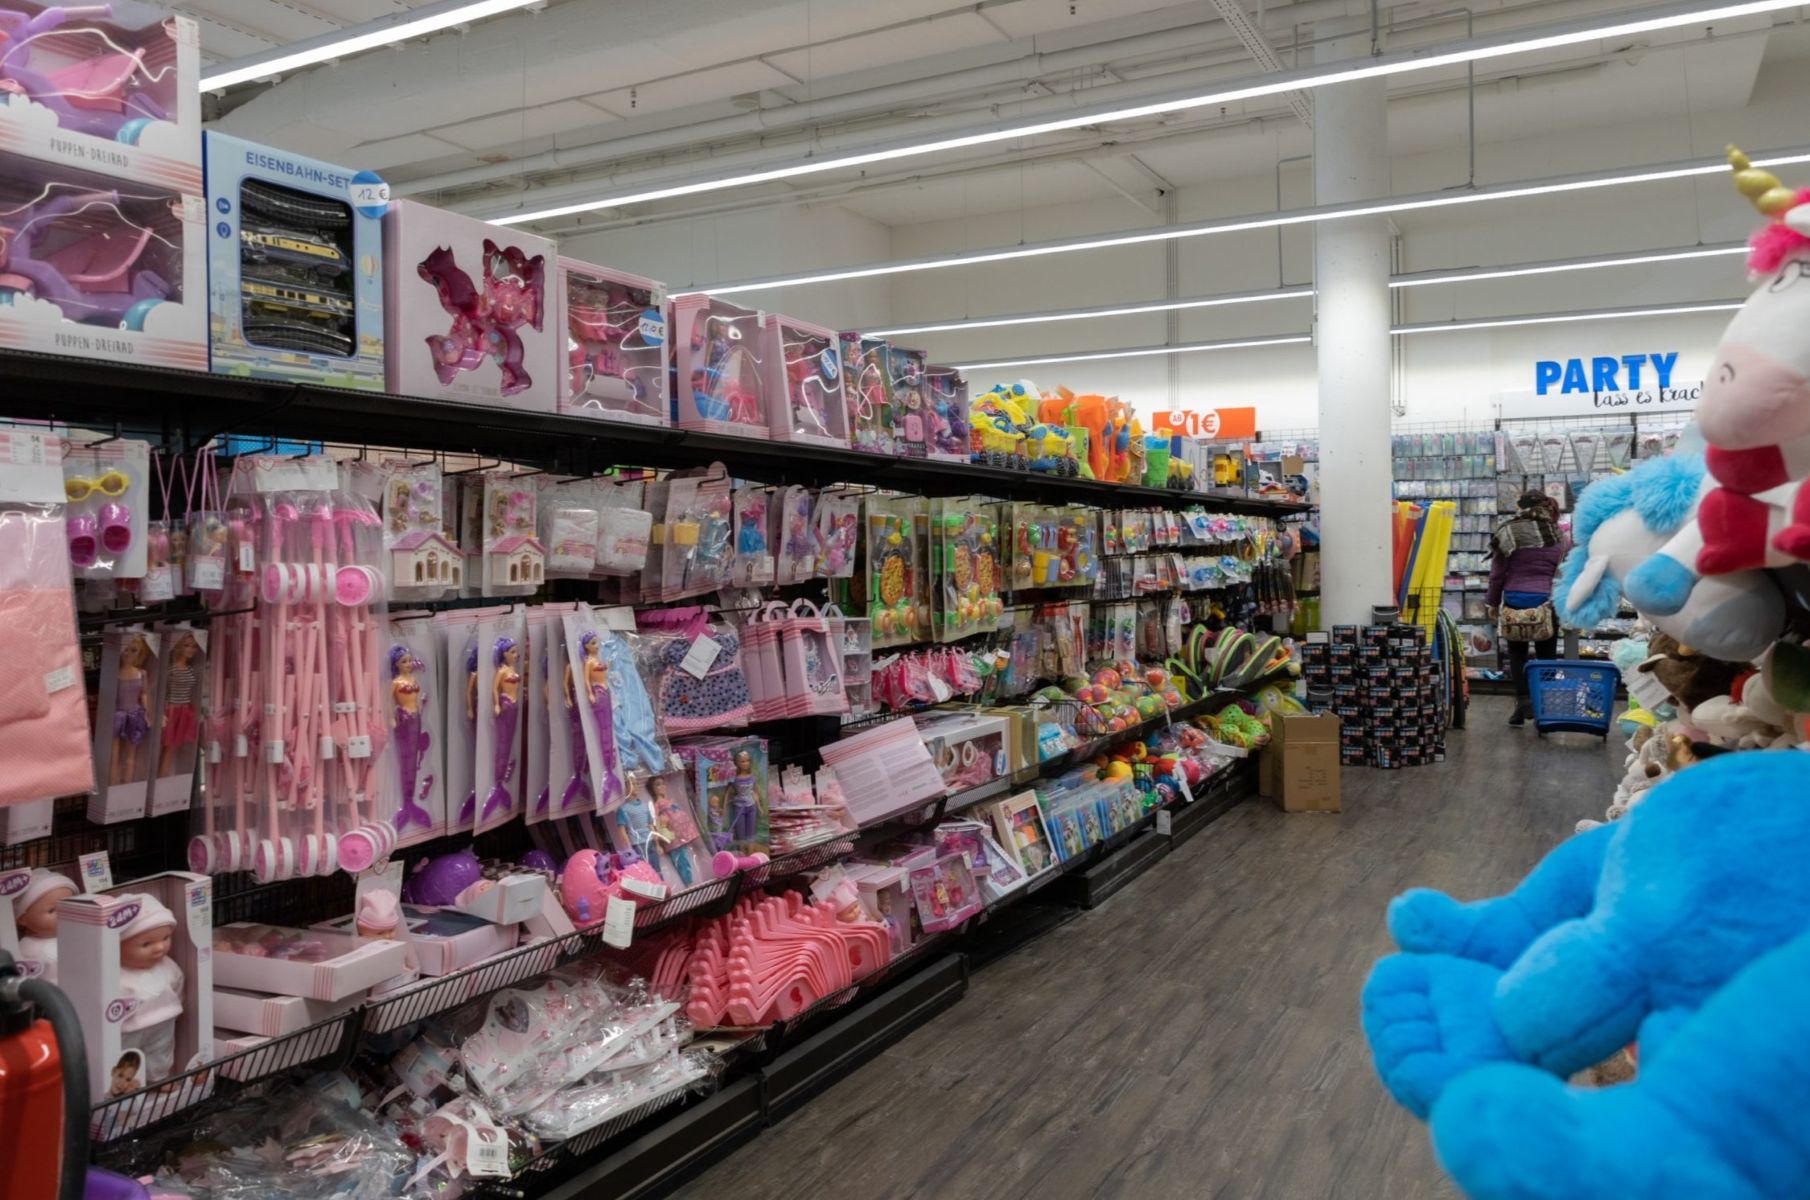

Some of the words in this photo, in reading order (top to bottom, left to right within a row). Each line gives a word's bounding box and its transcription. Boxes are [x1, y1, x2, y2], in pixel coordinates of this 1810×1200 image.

[50, 138, 129, 168] PUPPEN-DREIRAD
[245, 151, 351, 190] EISENBAHN-SET
[54, 333, 134, 354] PUPPEN-DREIRAD
[1536, 351, 1679, 396] PARTY
[1636, 391, 1653, 404] es
